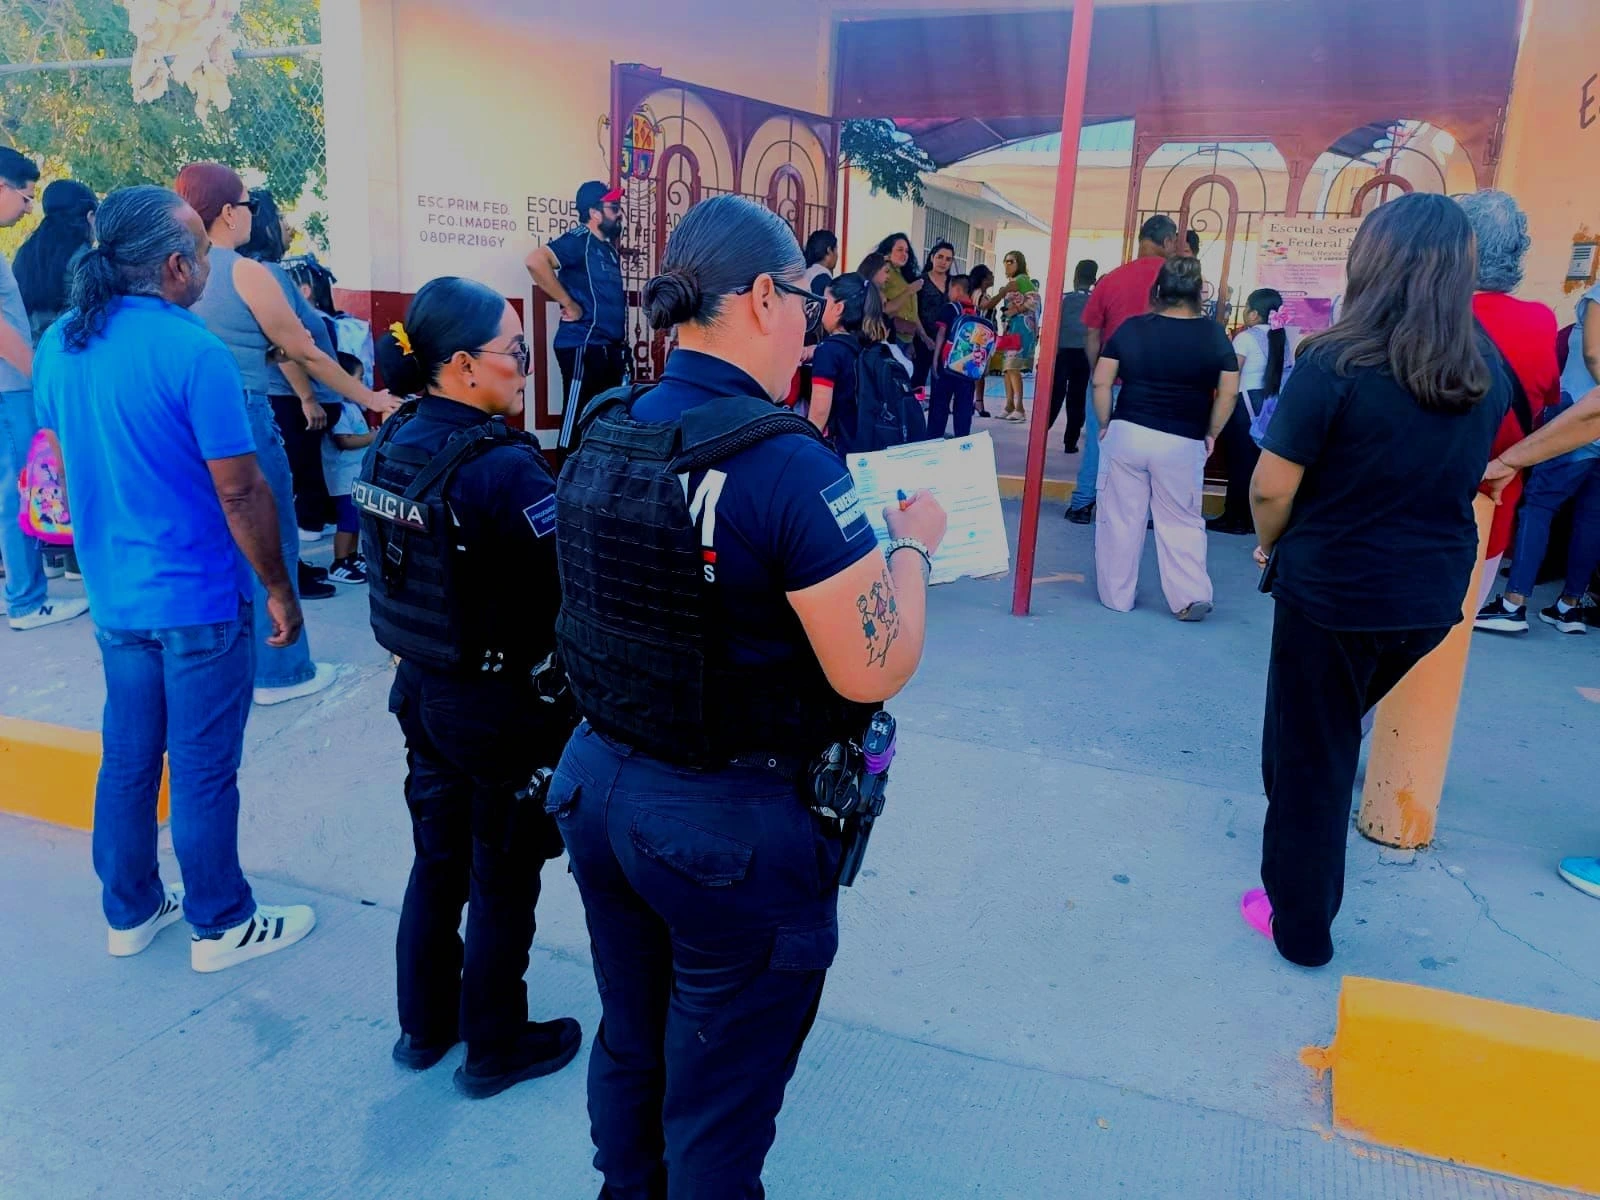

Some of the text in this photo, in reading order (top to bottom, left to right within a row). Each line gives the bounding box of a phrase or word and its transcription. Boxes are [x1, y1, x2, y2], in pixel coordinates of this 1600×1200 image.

[527, 216, 544, 233] EL
[1269, 223, 1324, 235] Escuela
[1288, 238, 1342, 248] Federal
[351, 482, 424, 525] POLICIA
